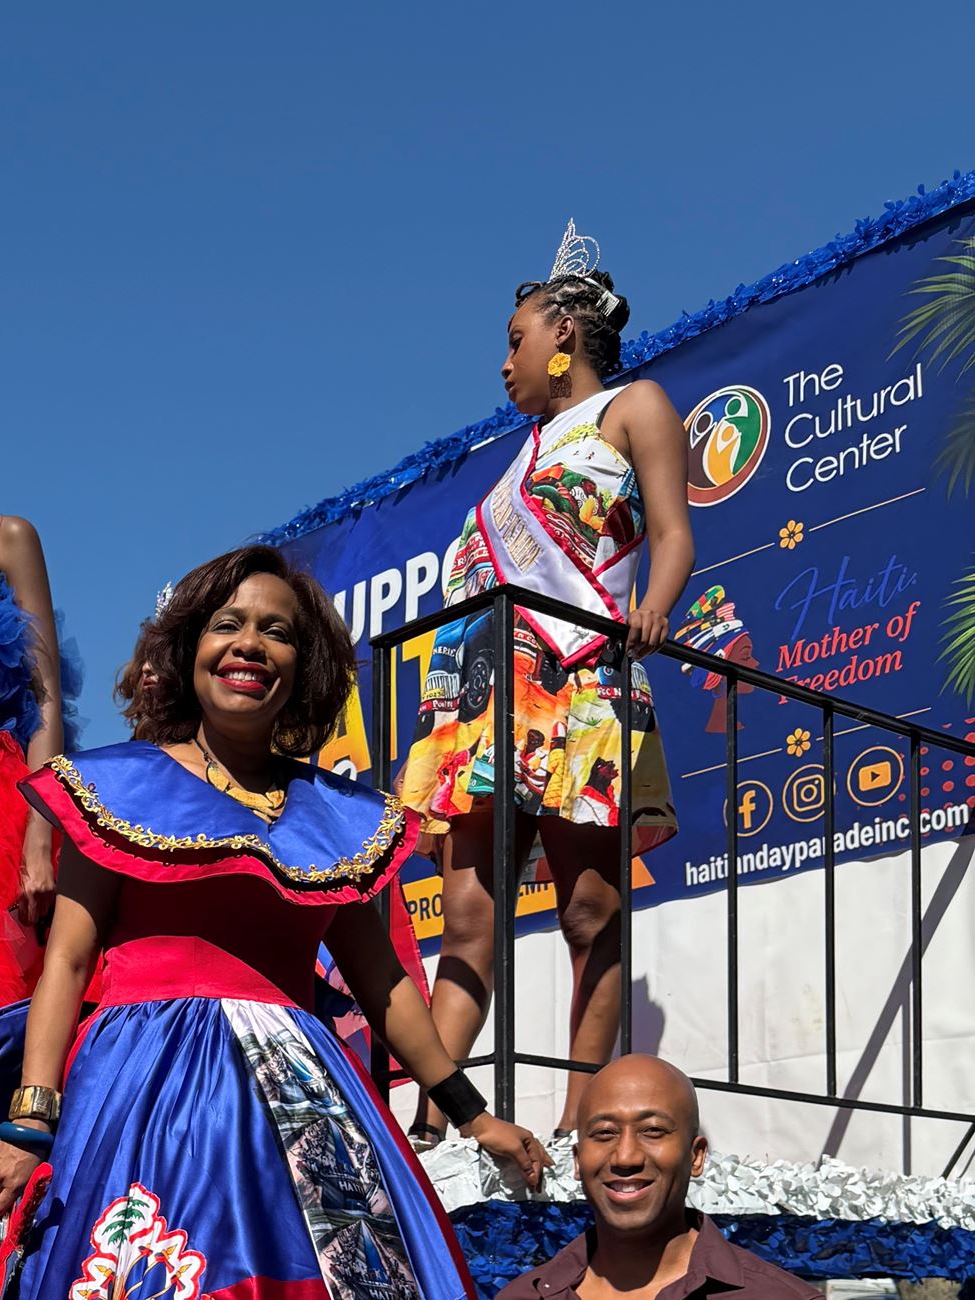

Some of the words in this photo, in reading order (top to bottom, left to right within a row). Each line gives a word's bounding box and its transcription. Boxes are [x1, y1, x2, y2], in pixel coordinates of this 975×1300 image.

[783, 363, 844, 407] The
[784, 362, 923, 449] Cultural
[785, 424, 908, 493] Center
[775, 619, 880, 673] Mother
[886, 600, 921, 642] of
[685, 803, 969, 887] haitindaypaadeinccom
